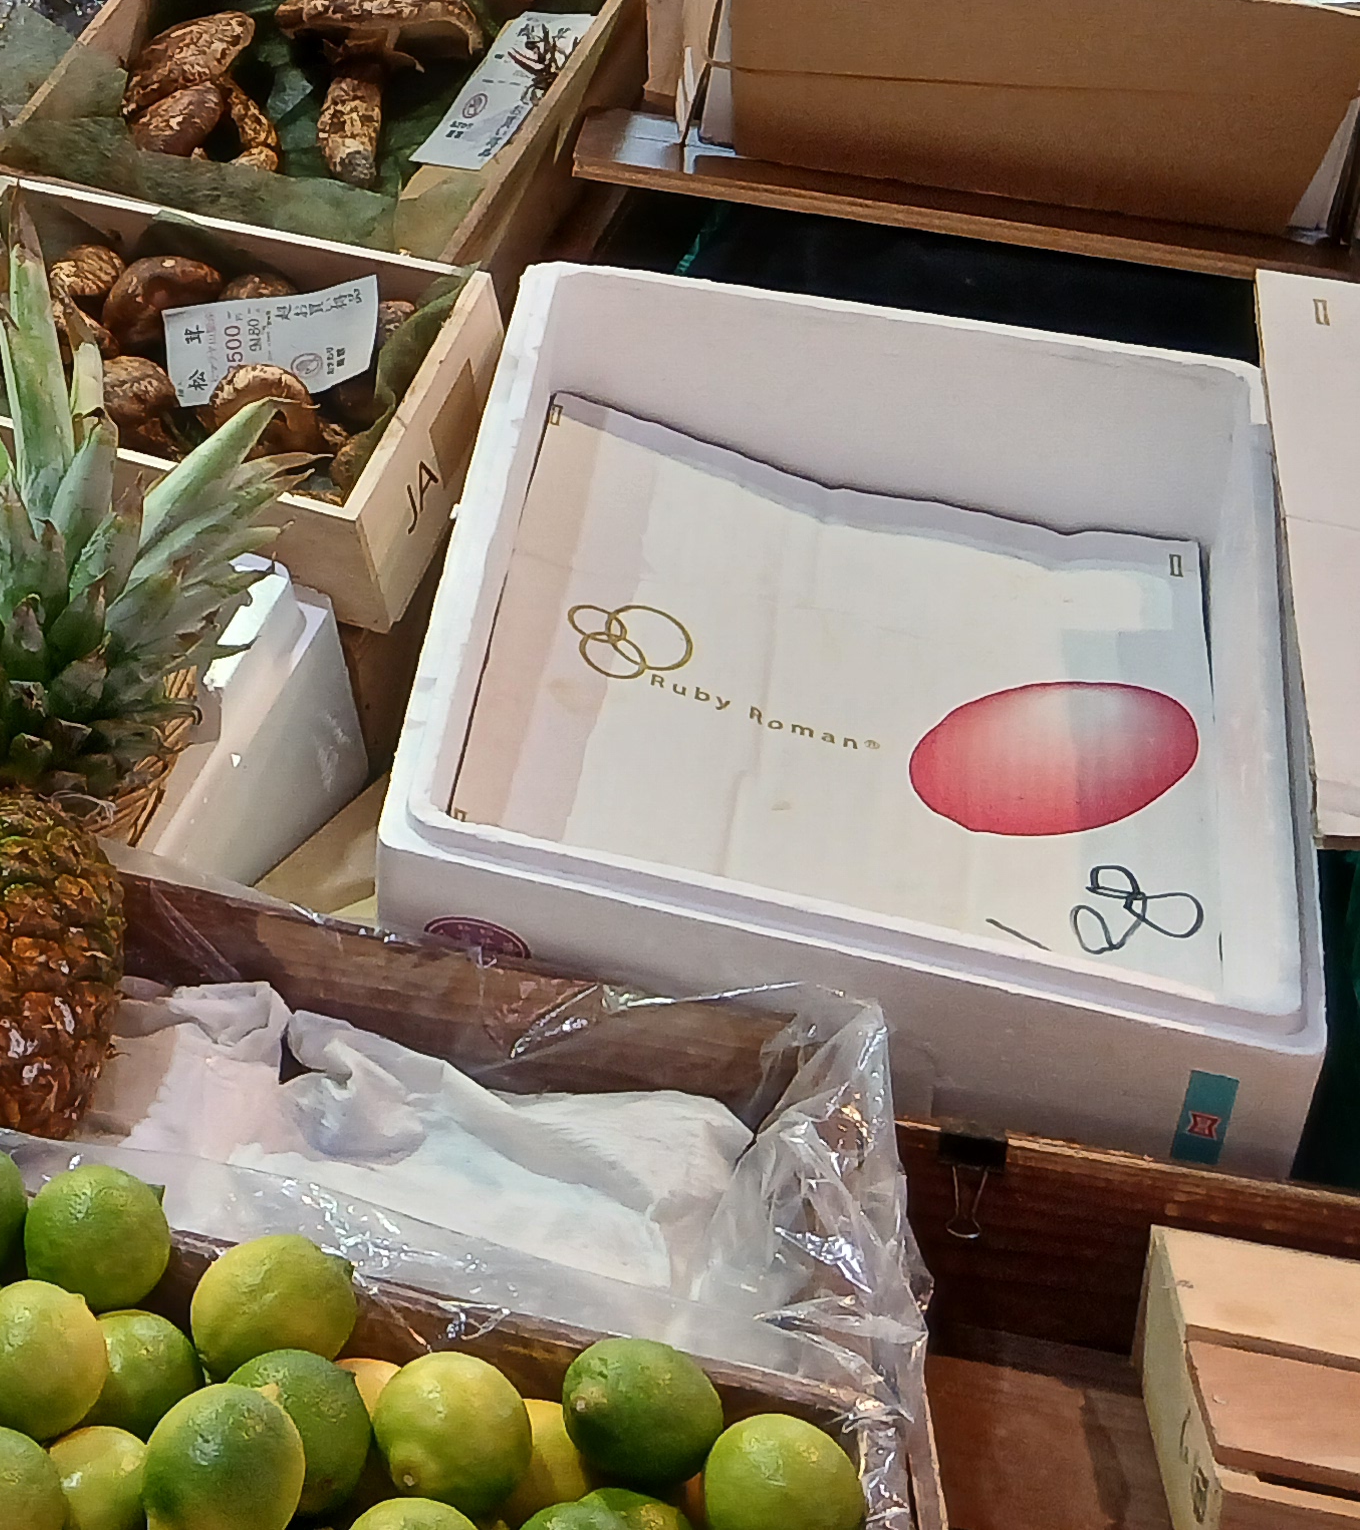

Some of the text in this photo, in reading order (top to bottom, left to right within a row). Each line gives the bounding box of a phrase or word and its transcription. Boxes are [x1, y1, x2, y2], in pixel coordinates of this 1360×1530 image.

[184, 325, 208, 391] 松茸
[224, 325, 244, 370] 500
[406, 460, 439, 535] JA
[650, 673, 731, 711] Ruby
